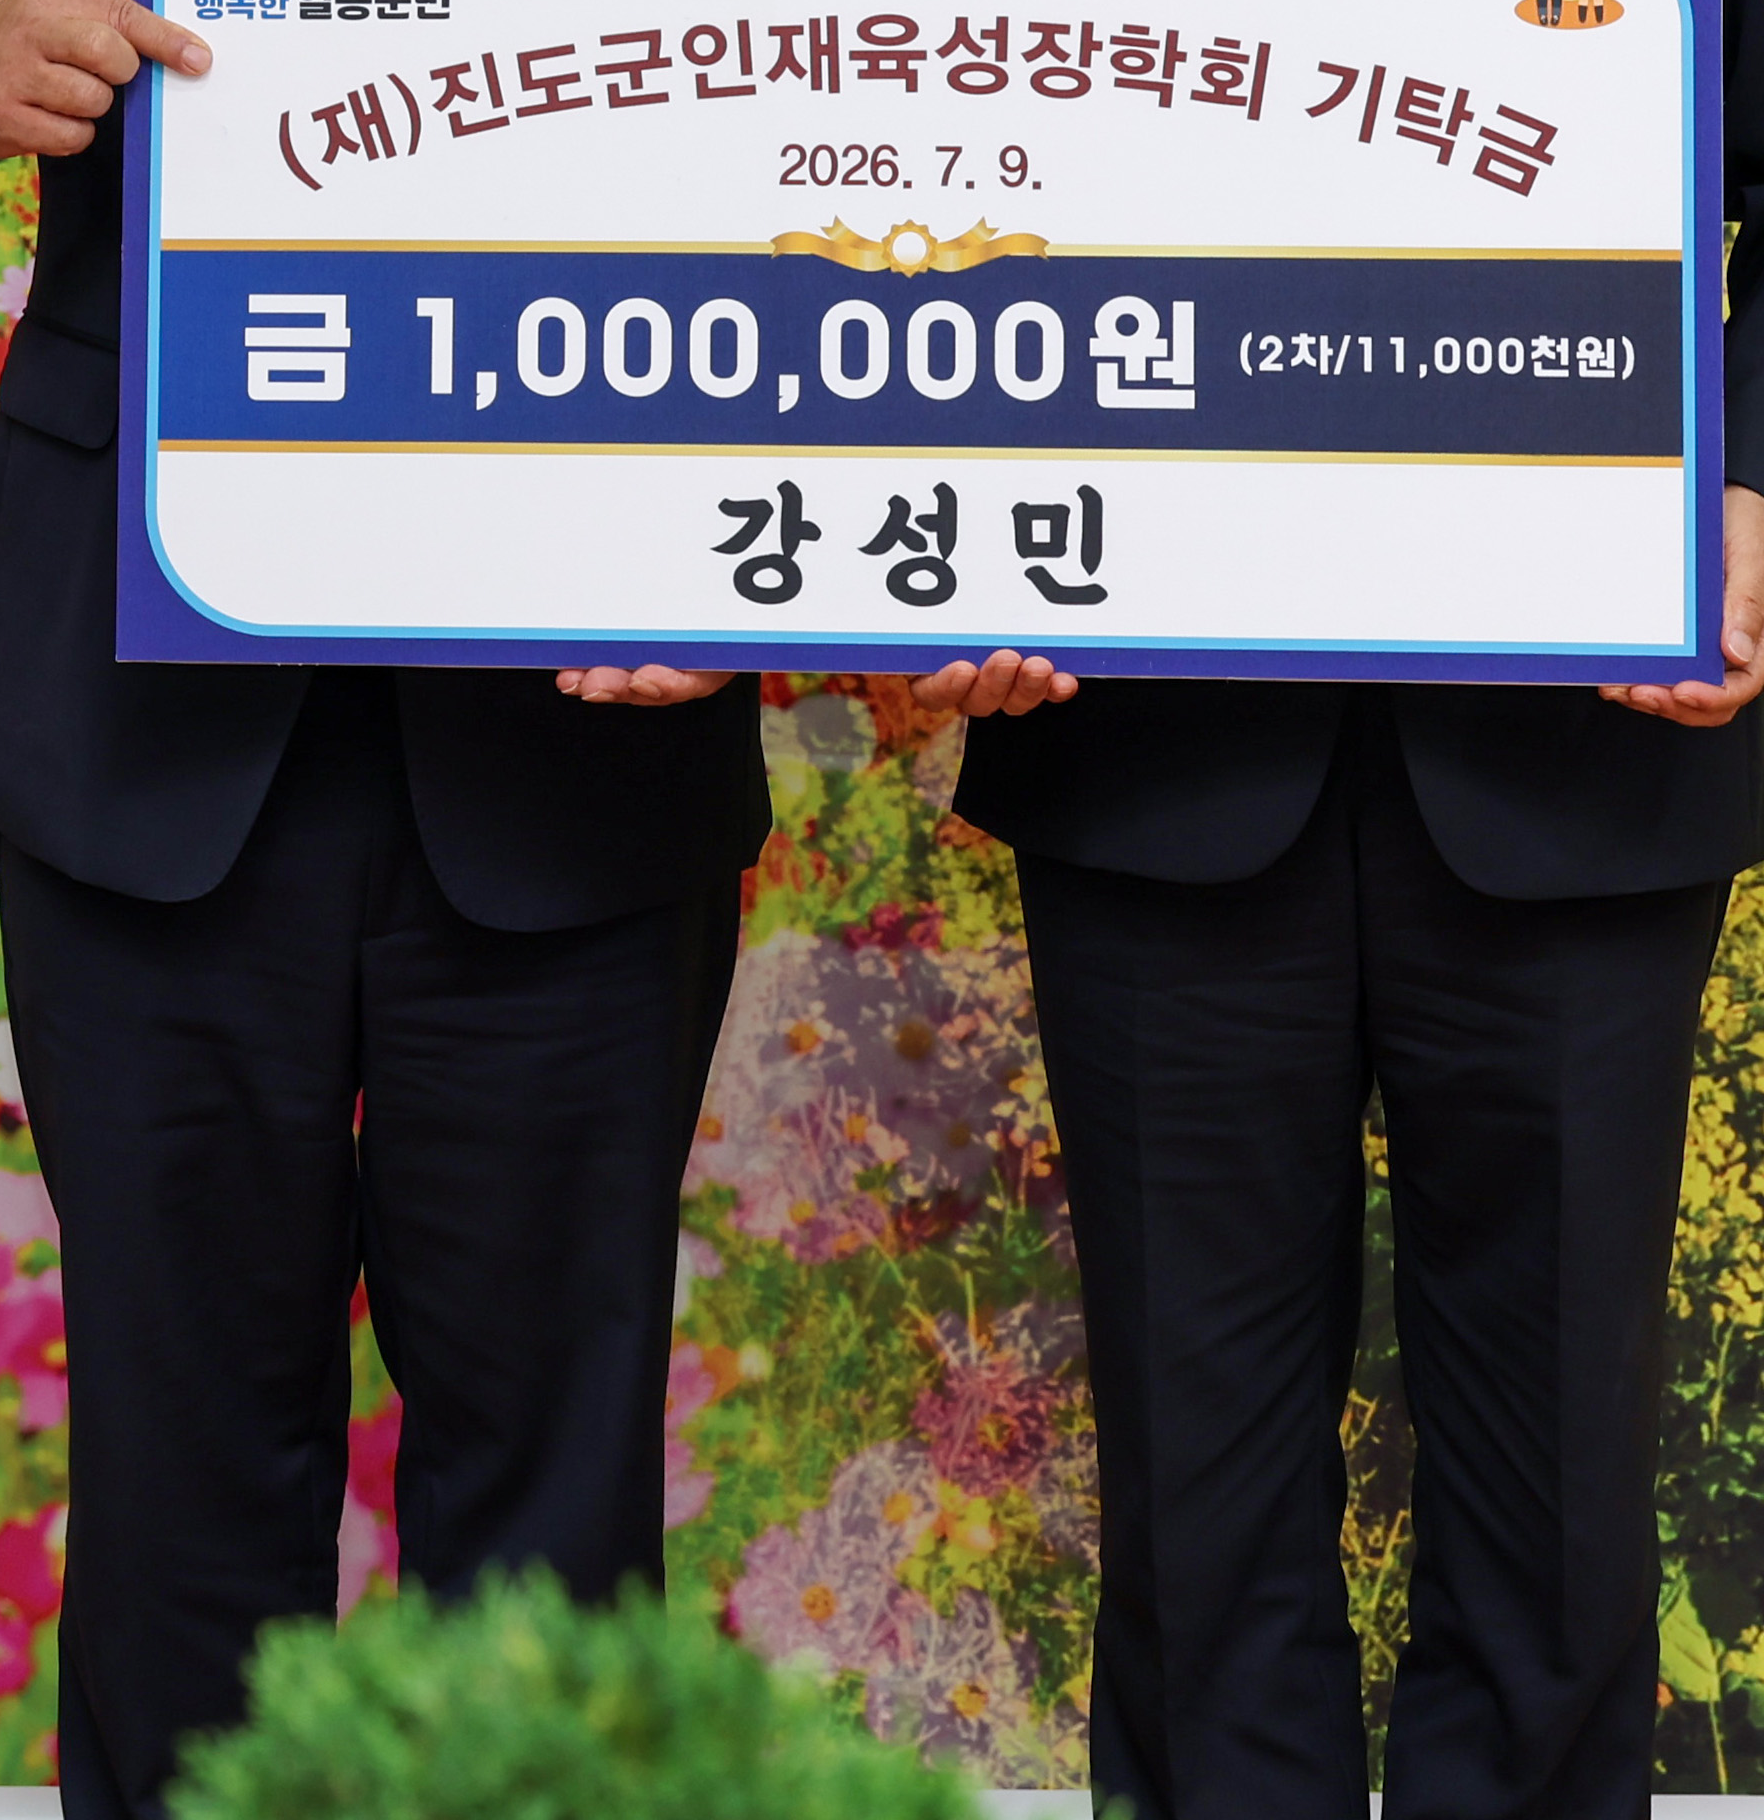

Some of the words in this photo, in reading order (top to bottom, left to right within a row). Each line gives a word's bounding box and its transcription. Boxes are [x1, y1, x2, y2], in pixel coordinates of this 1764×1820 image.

[278, 14, 1271, 191] (재)진도군인재육성장학회
[1305, 62, 1558, 197] 기탁금
[779, 144, 912, 189] 2026.
[936, 146, 974, 189] 7.
[999, 145, 1041, 189] 9.
[245, 294, 350, 401] 금
[417, 296, 1195, 413] 1,000,000원
[1240, 332, 1634, 380] (2차/11,000천원)
